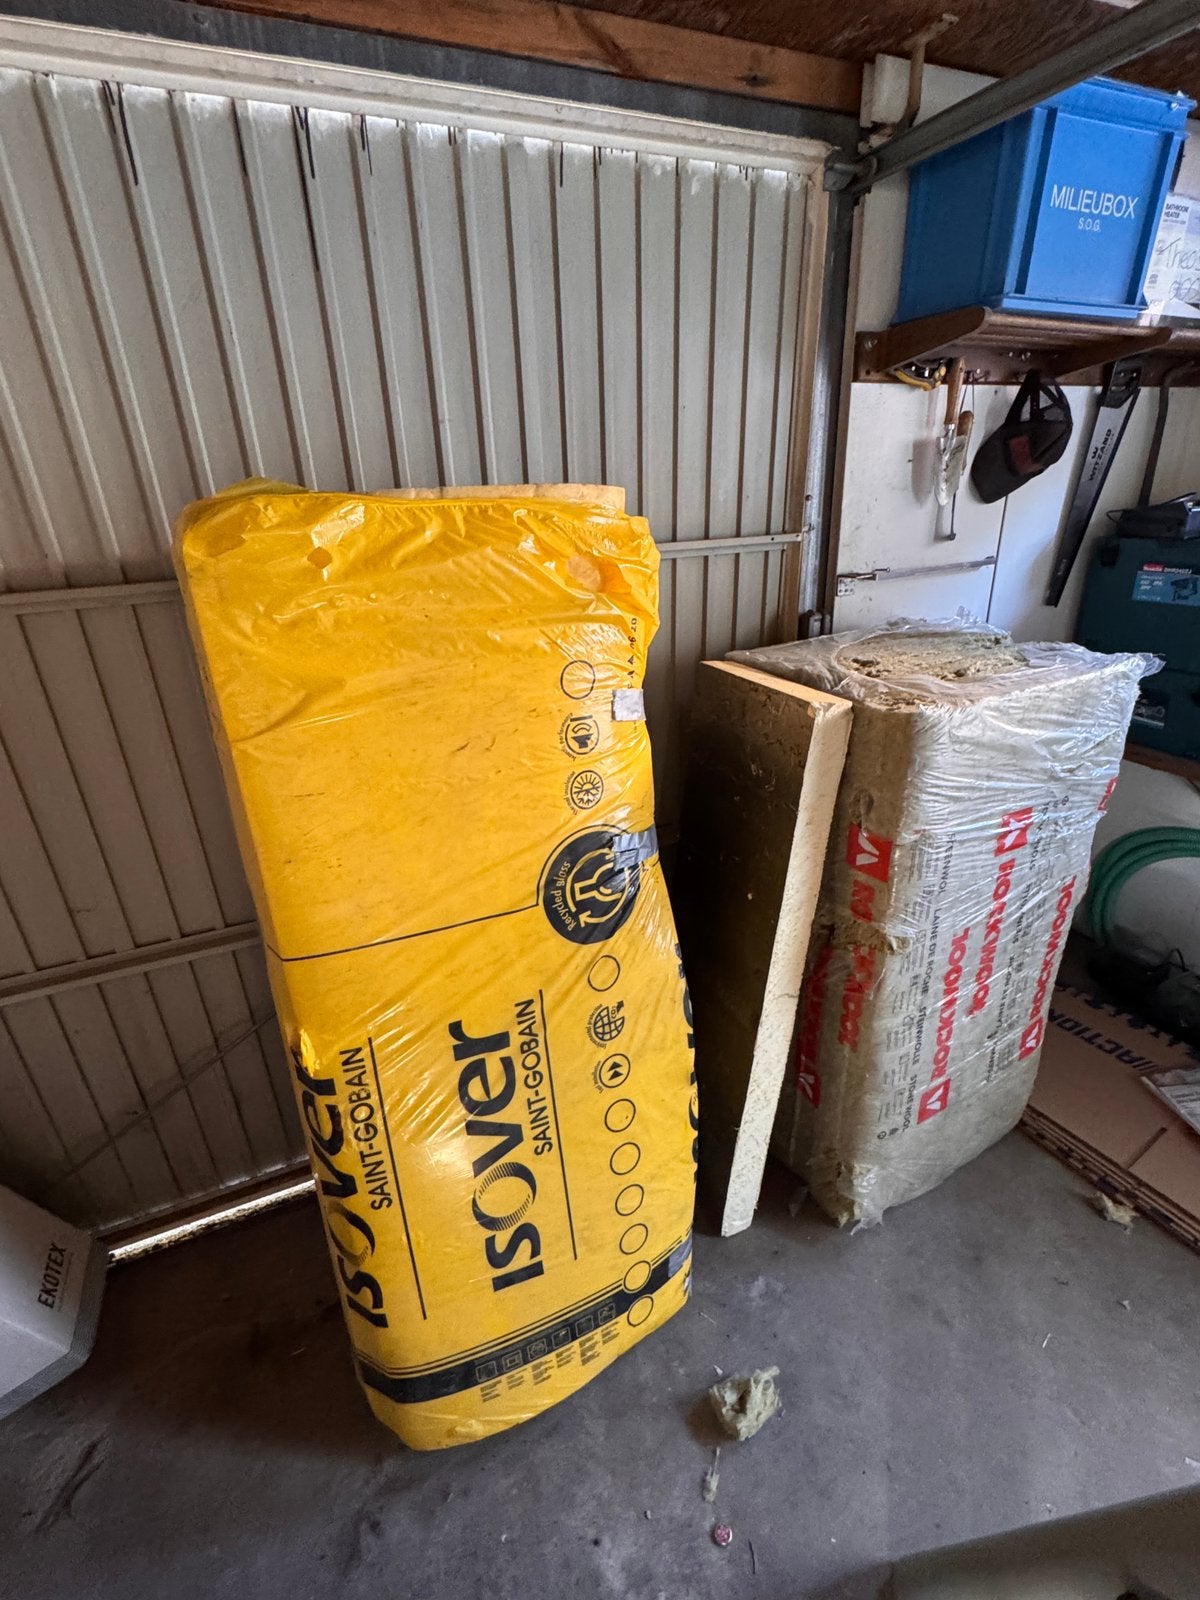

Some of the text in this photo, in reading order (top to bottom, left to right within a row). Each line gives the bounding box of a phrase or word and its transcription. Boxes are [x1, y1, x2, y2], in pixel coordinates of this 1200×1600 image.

[1050, 184, 1139, 219] MILIEUBOX
[551, 861, 576, 931] Recycled glass
[930, 907, 942, 942] LAINE
[1030, 874, 1077, 1020] ROCKWOOL
[931, 926, 971, 1082] ROCKWOOL
[339, 1047, 393, 1211] SAINT-GOBAIN
[514, 998, 553, 1157] SAINT-GOBAIN
[37, 1242, 66, 1309] EKOTEX
